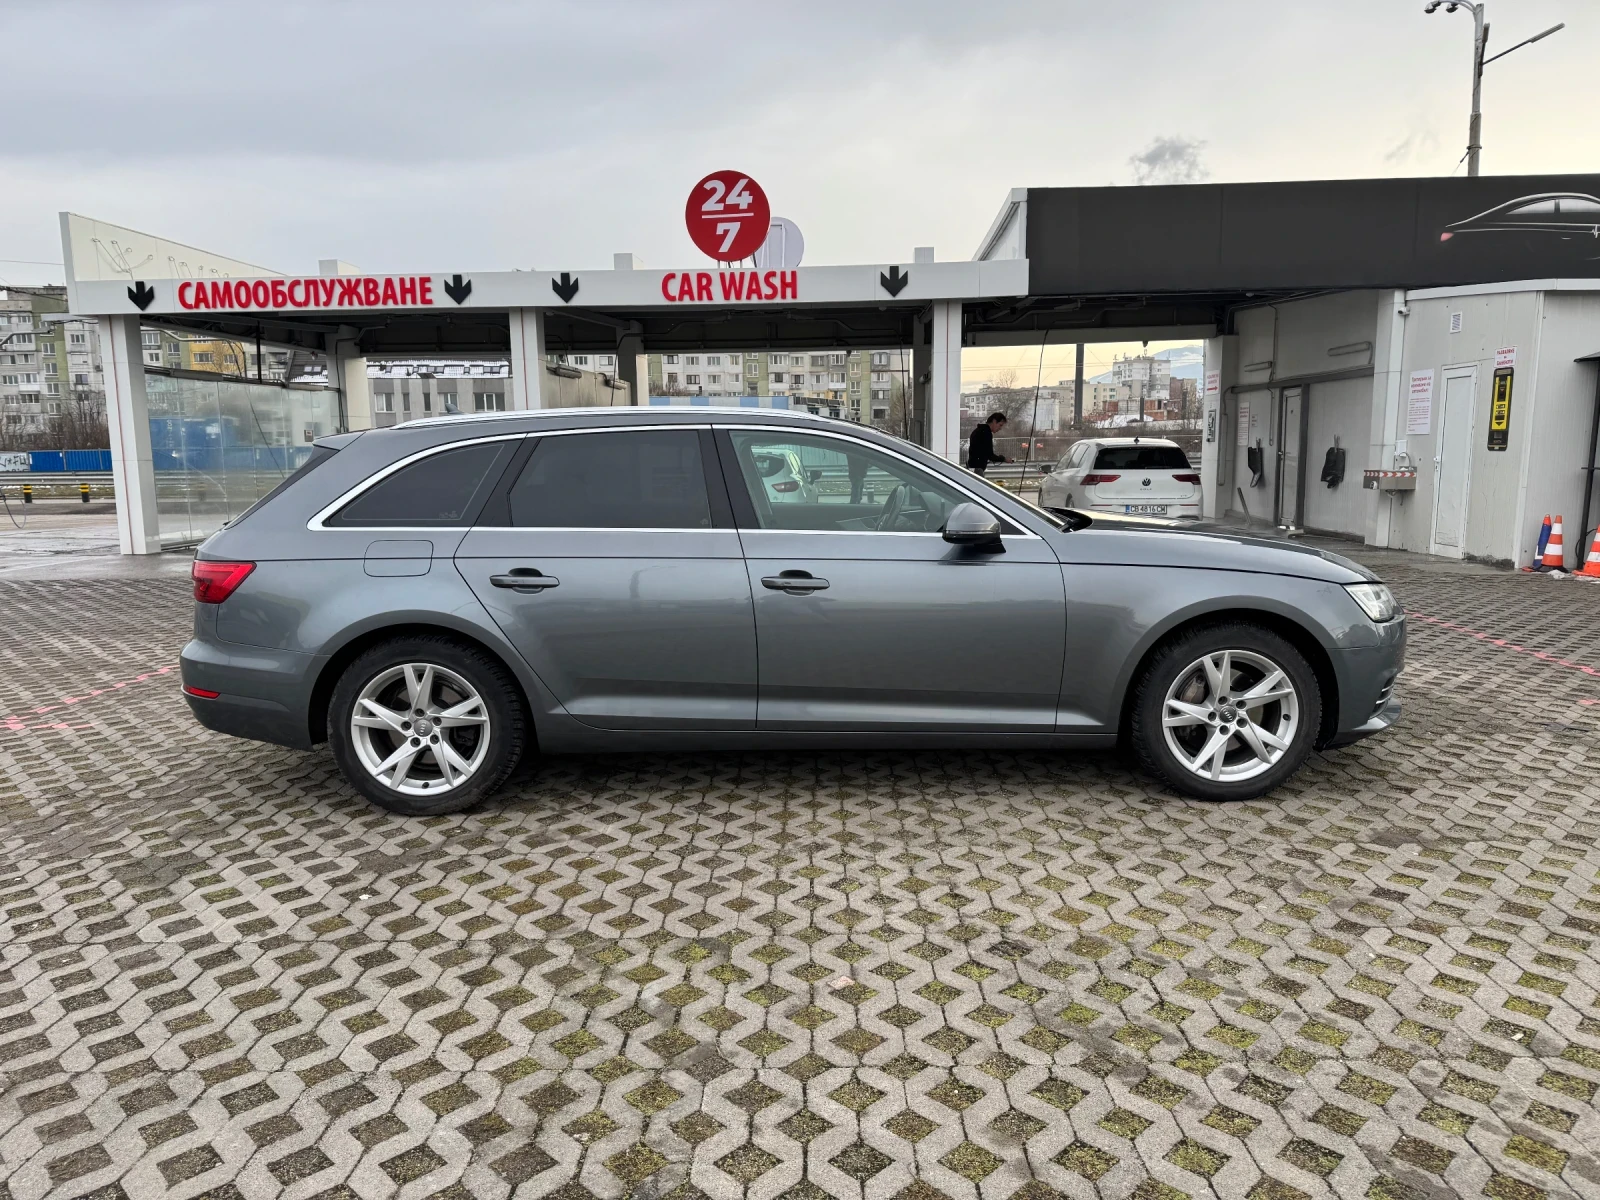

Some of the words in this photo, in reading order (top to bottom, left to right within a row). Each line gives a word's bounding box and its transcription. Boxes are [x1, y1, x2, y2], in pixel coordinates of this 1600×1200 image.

[701, 178, 754, 212] 24
[715, 221, 742, 253] 7
[178, 276, 434, 310] САМООБСЛУЖВАНЕ
[661, 272, 714, 302] CAR
[718, 270, 798, 301] WASH
